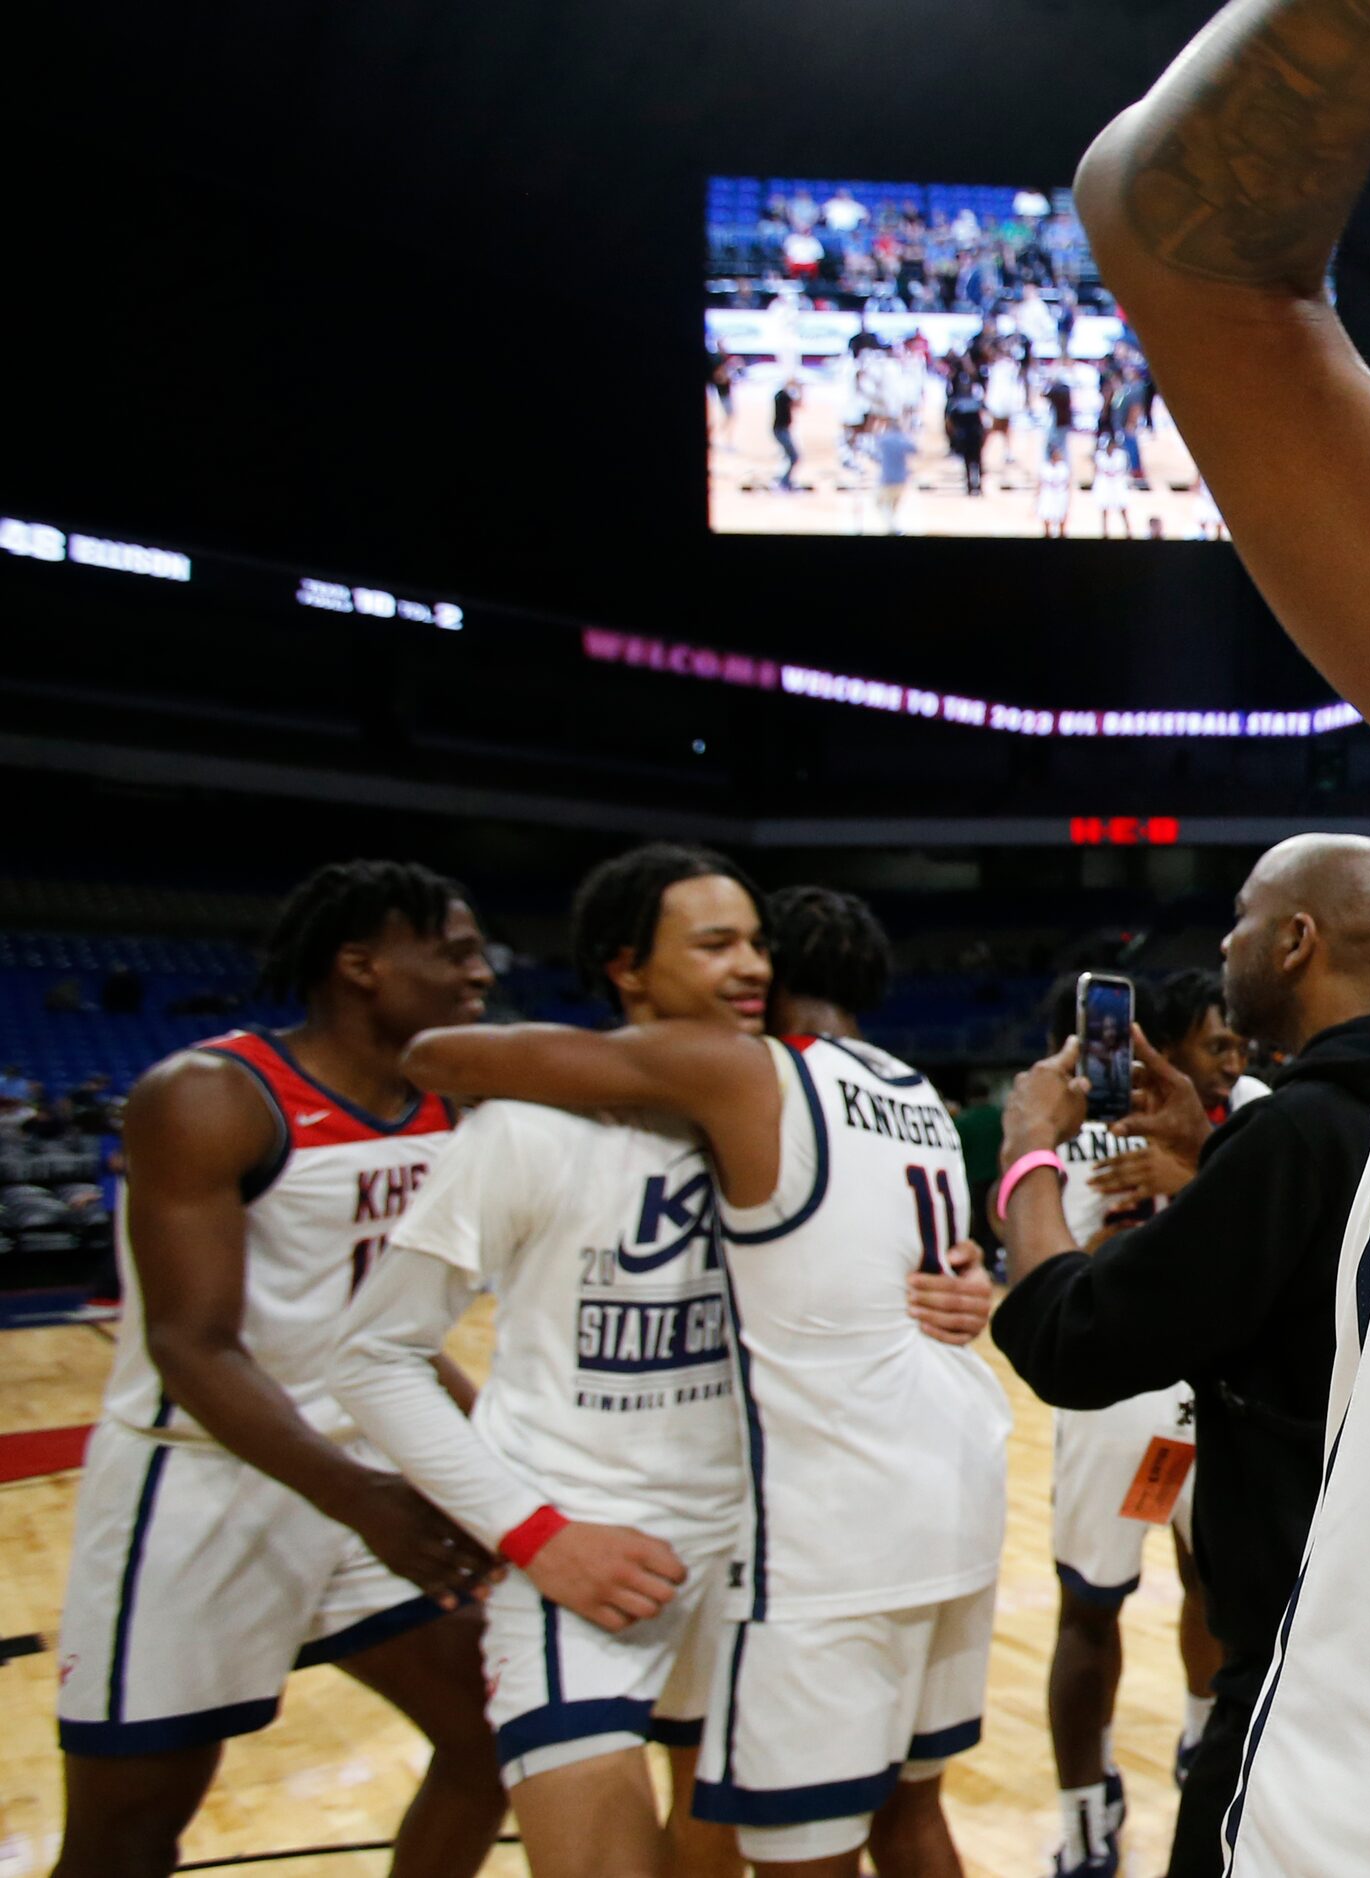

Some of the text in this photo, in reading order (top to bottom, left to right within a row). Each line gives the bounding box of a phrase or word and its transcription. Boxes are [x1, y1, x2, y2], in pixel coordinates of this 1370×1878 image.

[581, 626, 778, 690] WELCOME
[781, 664, 903, 712] WELCOME
[906, 688, 939, 718] TO
[943, 695, 986, 727] THE
[1102, 711, 1241, 736] BASKETBALL
[1246, 711, 1311, 736] STATE
[905, 1165, 957, 1274] 11
[578, 1303, 680, 1361] STATE
